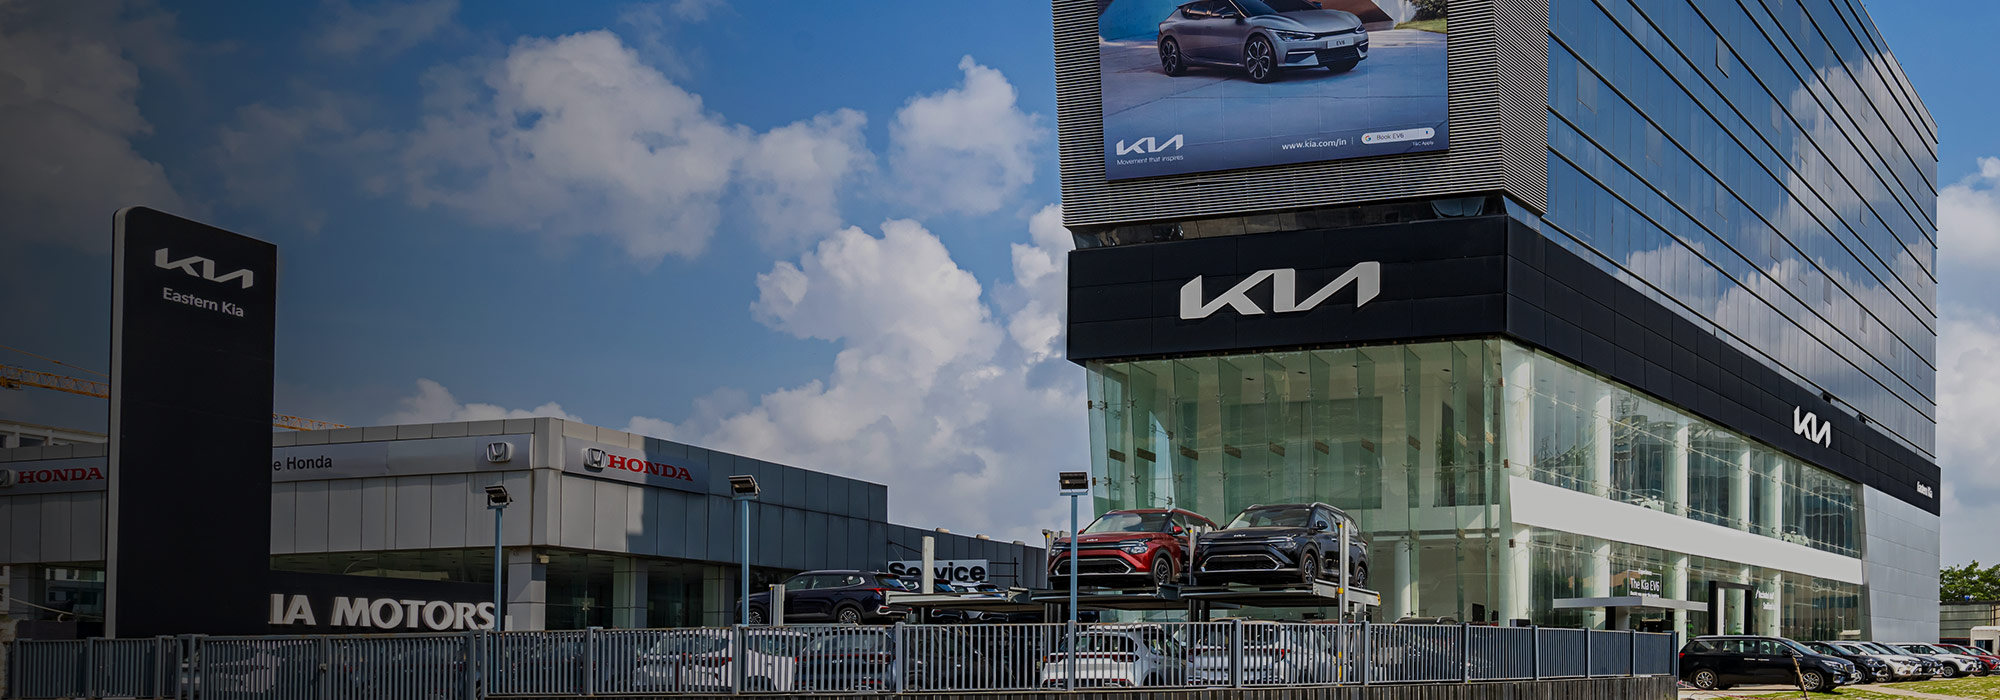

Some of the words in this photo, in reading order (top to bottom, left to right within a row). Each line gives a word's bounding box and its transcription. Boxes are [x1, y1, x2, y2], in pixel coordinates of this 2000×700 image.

[1116, 134, 1183, 156] KIA
[1281, 138, 1347, 150] www.kia.com/in
[1116, 157, 1148, 166] Movement
[1161, 154, 1184, 163] inspires
[155, 247, 254, 289] KIA
[1180, 261, 1381, 320] KIA
[163, 287, 219, 312] Eastern
[222, 301, 244, 317] Kia
[287, 455, 333, 470] Honda
[607, 454, 694, 482] HONDA
[17, 467, 105, 484] HONDA
[888, 562, 986, 582] Sevice
[1630, 578, 1640, 589] The
[1641, 580, 1649, 590] Kia
[268, 593, 317, 626] IA
[330, 596, 495, 631] MOTORS
